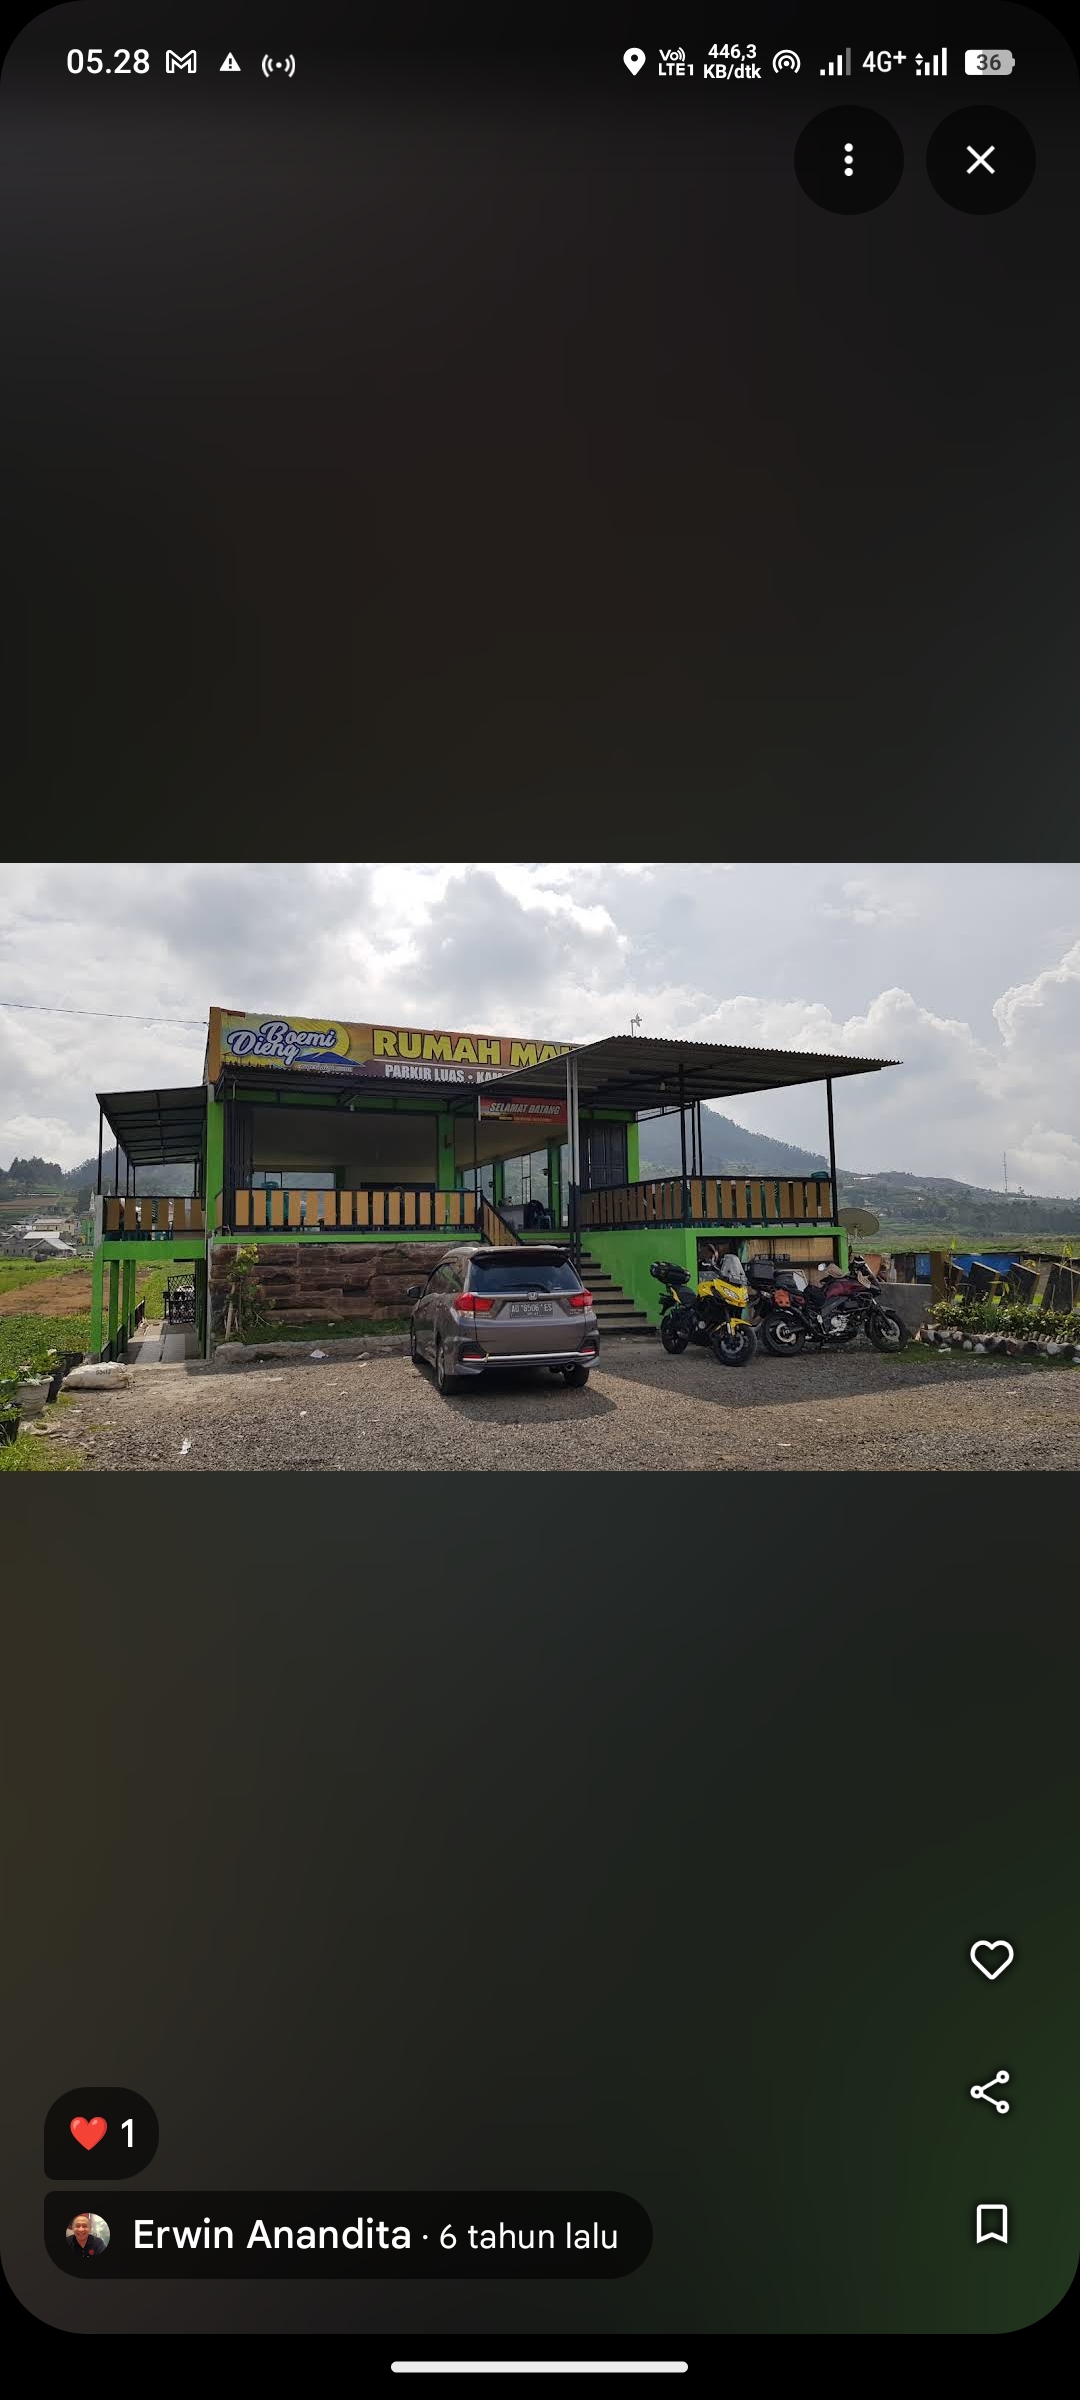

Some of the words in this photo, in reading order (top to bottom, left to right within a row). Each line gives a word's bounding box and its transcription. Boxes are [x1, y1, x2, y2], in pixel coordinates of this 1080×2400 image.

[227, 1030, 301, 1066] Dieng
[259, 1021, 338, 1048] Boemi
[373, 1029, 501, 1065] RUMAH
[385, 1064, 433, 1081] PARKIR
[434, 1068, 465, 1083] LUAS
[489, 1102, 528, 1113] SELAMAT
[528, 1105, 561, 1115] DATANG
